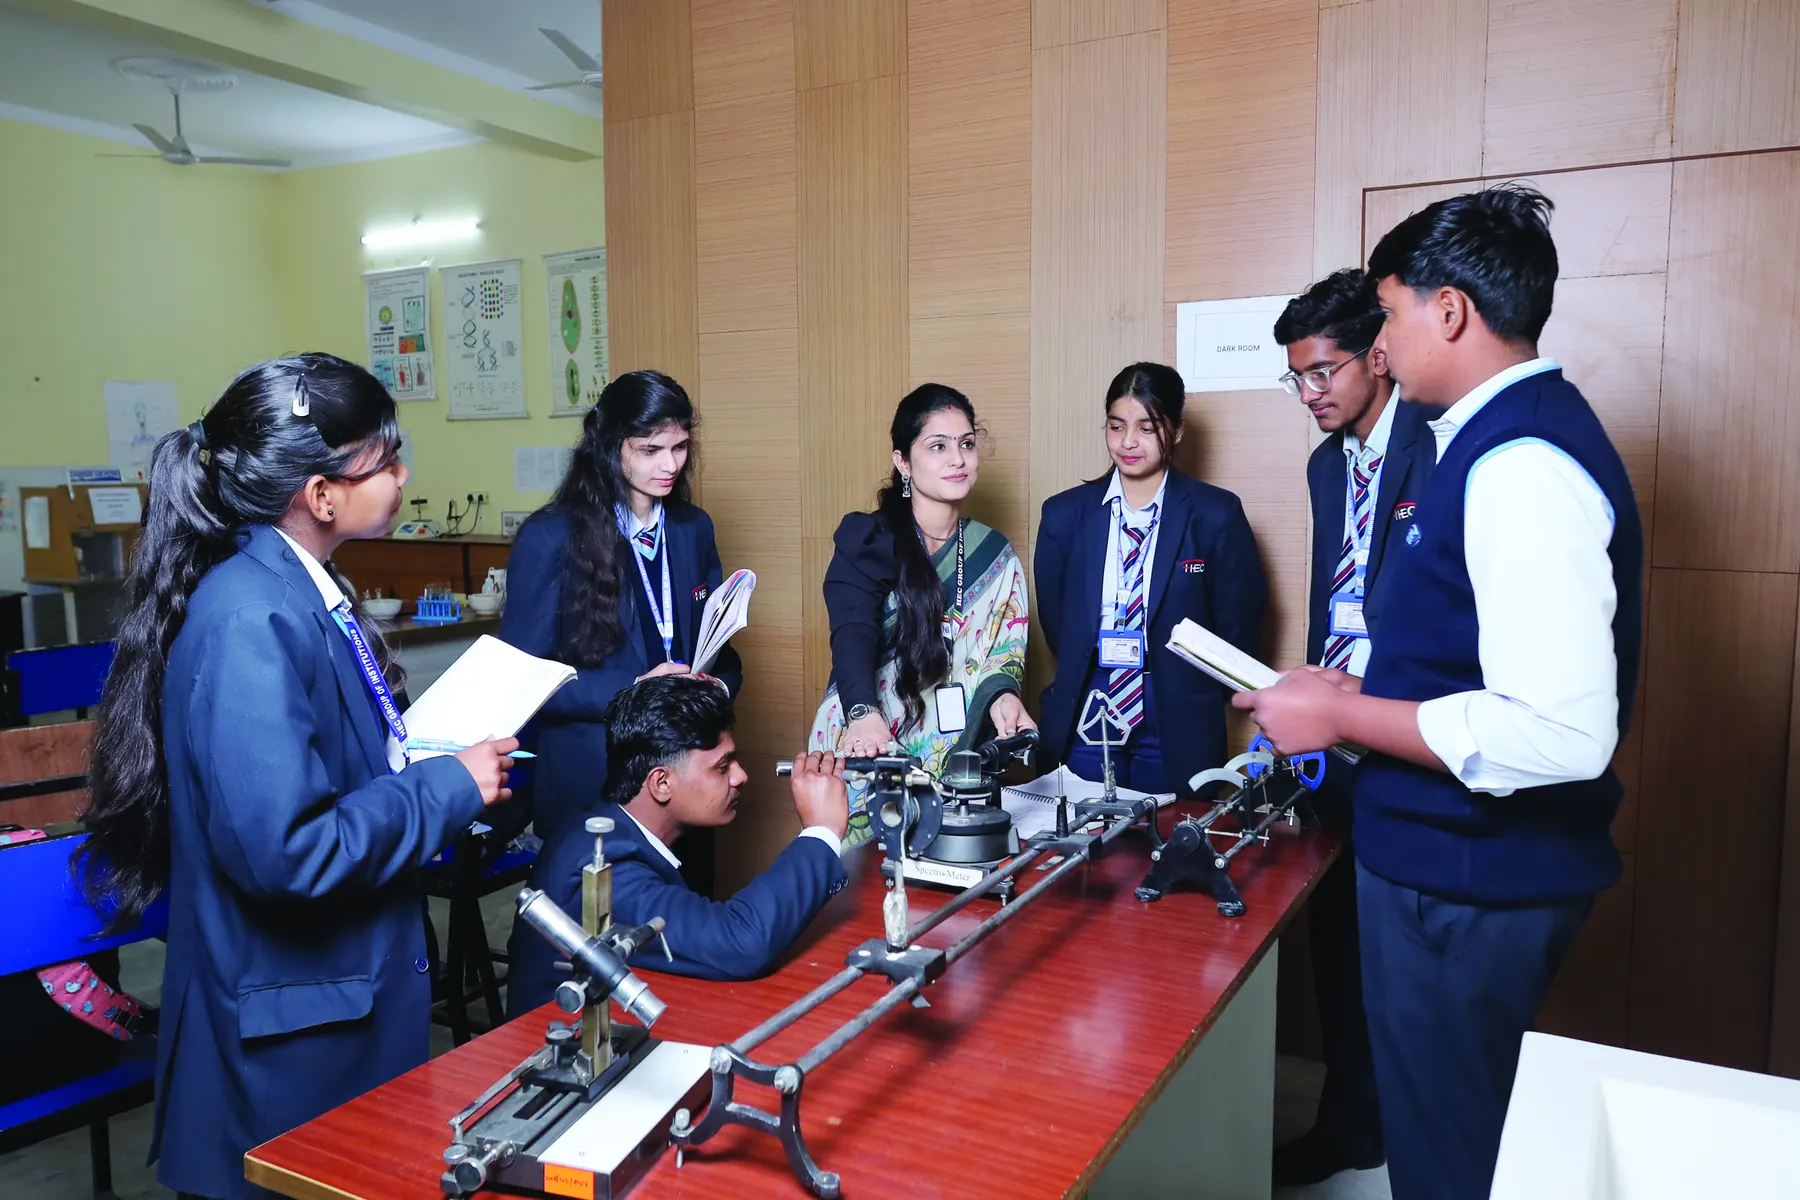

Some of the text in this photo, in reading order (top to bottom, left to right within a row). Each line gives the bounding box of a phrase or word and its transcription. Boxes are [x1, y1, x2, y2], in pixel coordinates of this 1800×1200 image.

[1395, 506, 1415, 520] HEC
[958, 543, 963, 555] OF
[1184, 564, 1204, 572] HEC
[350, 629, 406, 737] HEC GROUP OF INSTITUTIONS
[916, 865, 971, 880] Spectro-Meter
